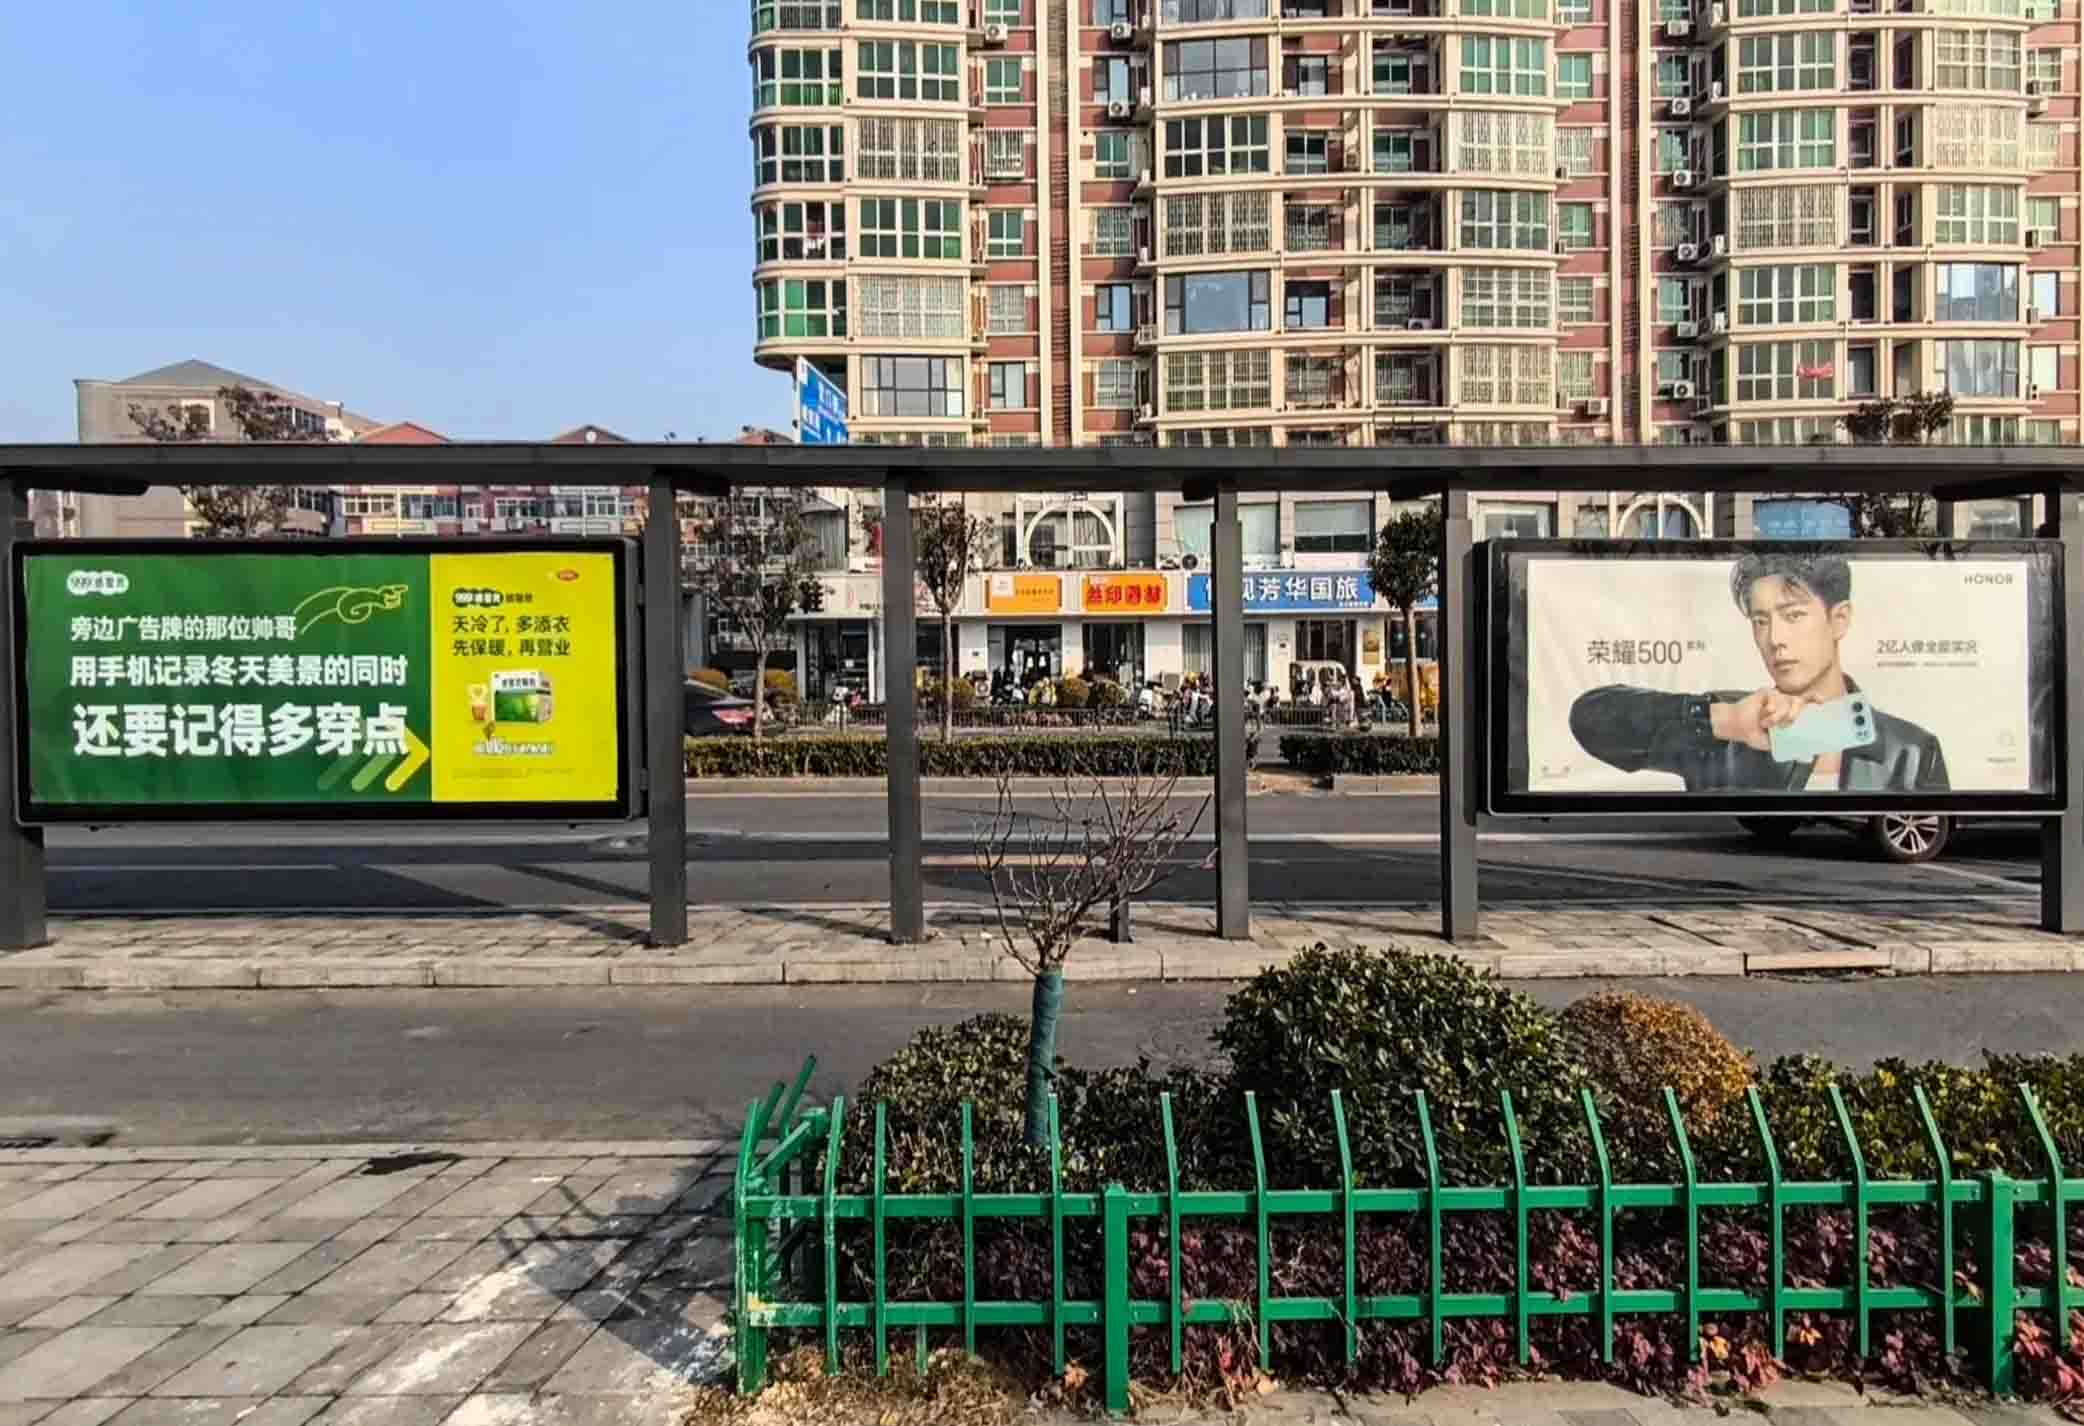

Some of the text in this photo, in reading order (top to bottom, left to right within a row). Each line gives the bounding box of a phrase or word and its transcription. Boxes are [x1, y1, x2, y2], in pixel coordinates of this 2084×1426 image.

[1963, 573, 2014, 585] HONOR
[71, 615, 297, 642] 旁边广告牌的那位帅哥
[1586, 638, 1683, 665] 荣耀500
[70, 654, 409, 688] 用手机记录冬天美景的同时
[72, 701, 410, 757] 还要记得多穿点
